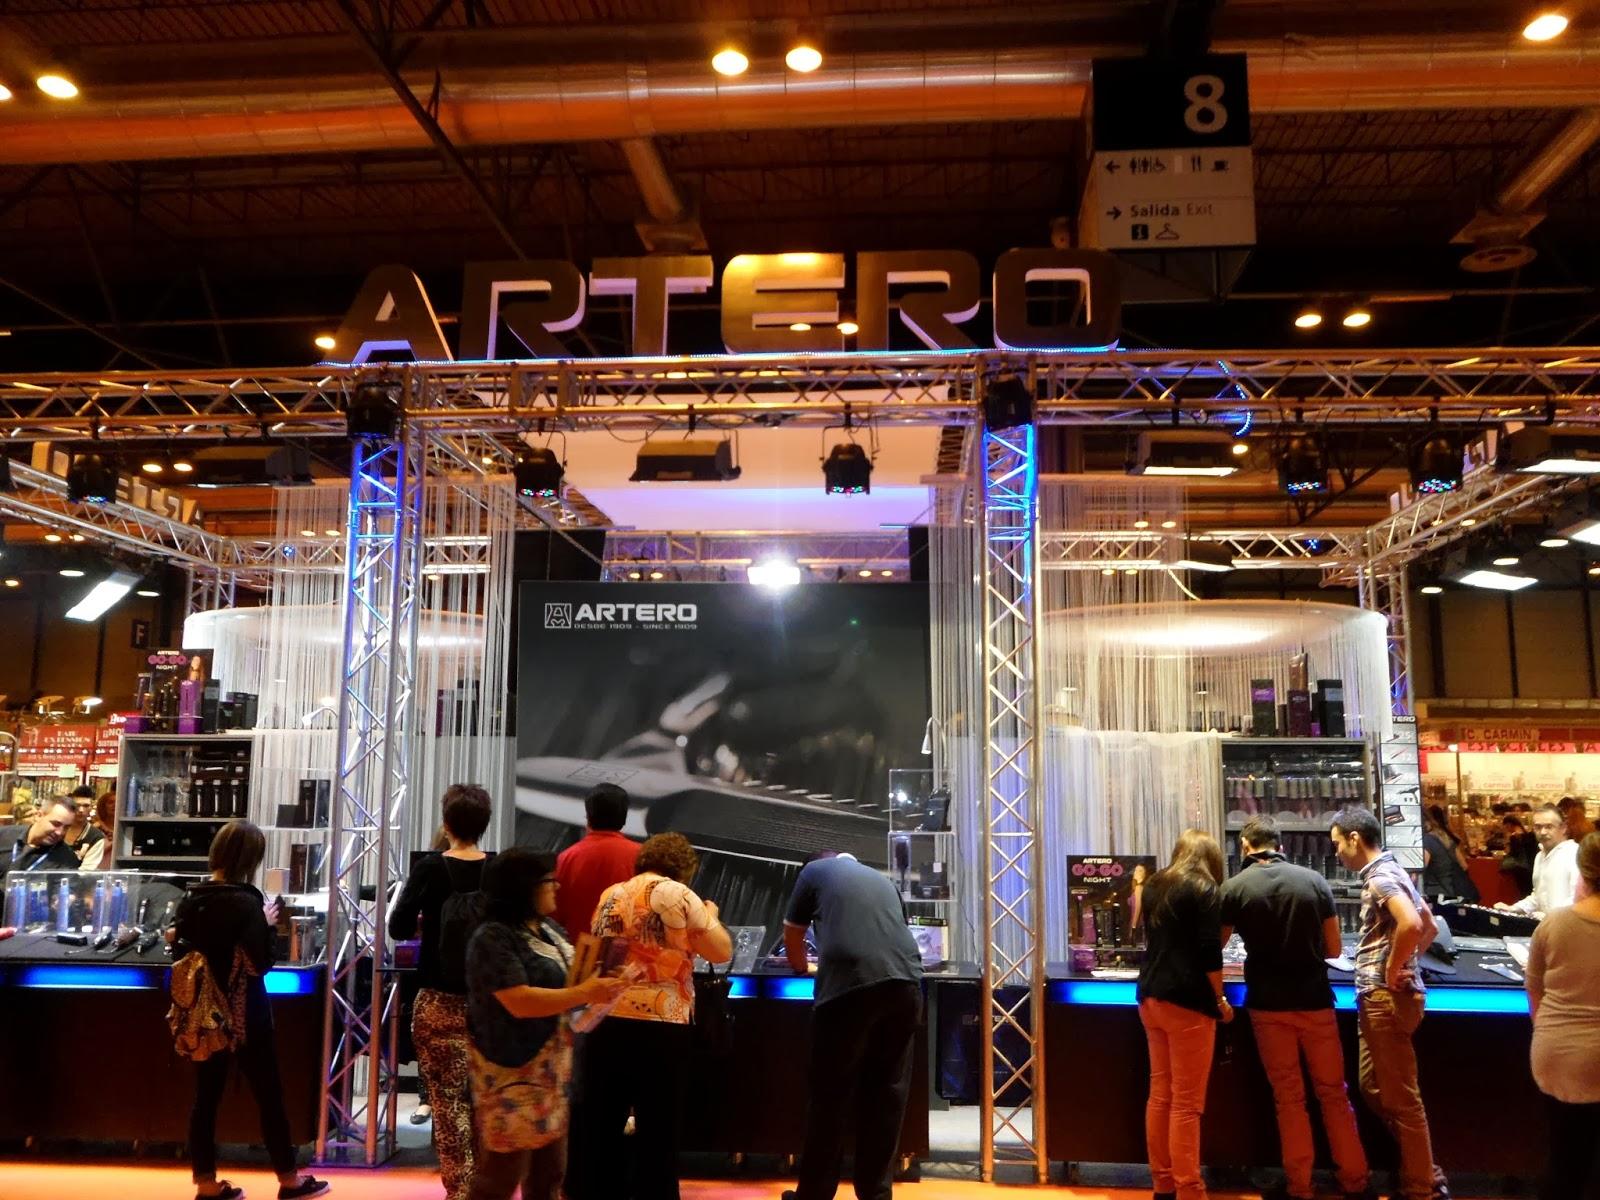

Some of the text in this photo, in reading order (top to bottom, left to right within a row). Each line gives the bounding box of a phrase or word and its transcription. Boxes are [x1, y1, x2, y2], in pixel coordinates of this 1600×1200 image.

[1184, 74, 1228, 133] 8
[1130, 203, 1213, 217] Salida Exit
[323, 246, 1121, 363] ARTERO
[575, 603, 697, 621] ARTERO
[135, 624, 144, 645] F
[1484, 729, 1532, 740] CARMIN
